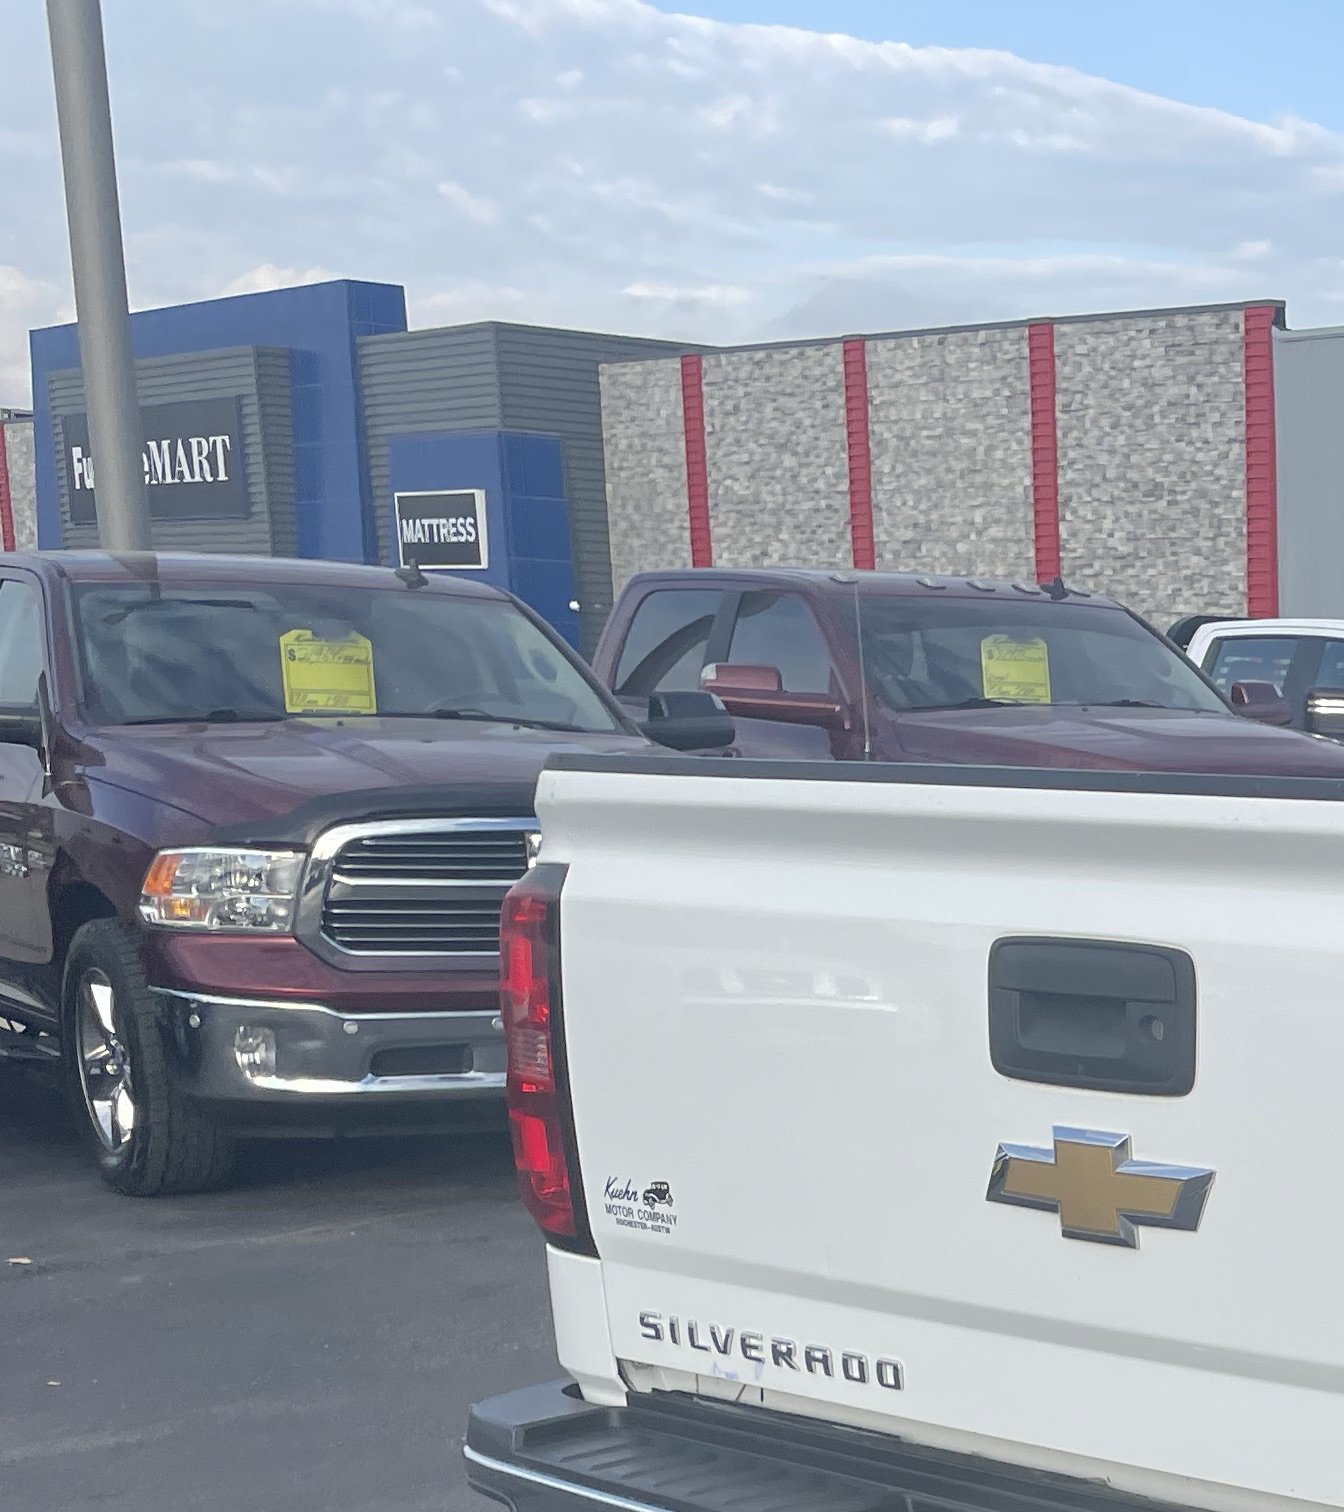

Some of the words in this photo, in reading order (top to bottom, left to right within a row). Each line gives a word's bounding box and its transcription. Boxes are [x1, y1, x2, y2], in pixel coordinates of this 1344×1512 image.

[402, 516, 477, 544] MATTRESS
[604, 1175, 639, 1202] Kuehn
[605, 1203, 635, 1219] MOTOR
[637, 1208, 678, 1227] COMPANY
[639, 1310, 905, 1391] SILVERADO
